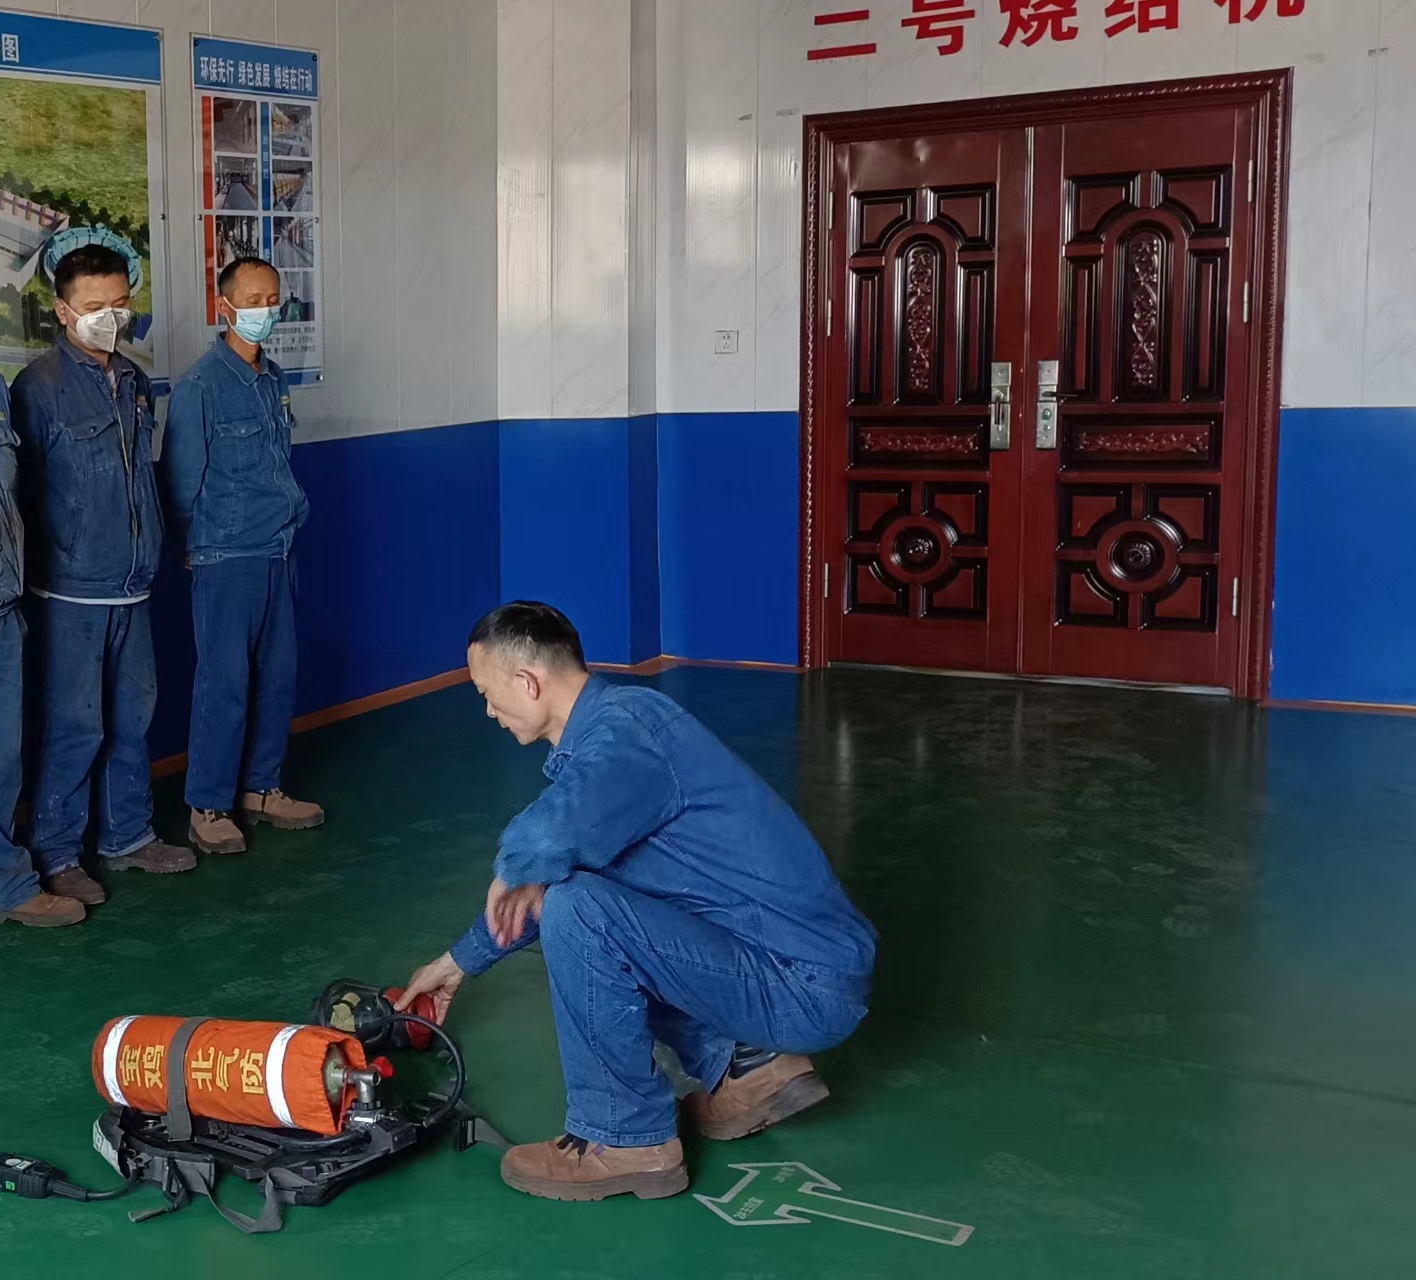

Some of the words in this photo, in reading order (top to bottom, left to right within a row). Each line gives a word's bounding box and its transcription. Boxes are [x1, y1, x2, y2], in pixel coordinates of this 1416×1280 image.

[199, 56, 234, 84] 环保先行
[238, 60, 271, 88] 绿色发展
[274, 64, 313, 92] 烧结在行动
